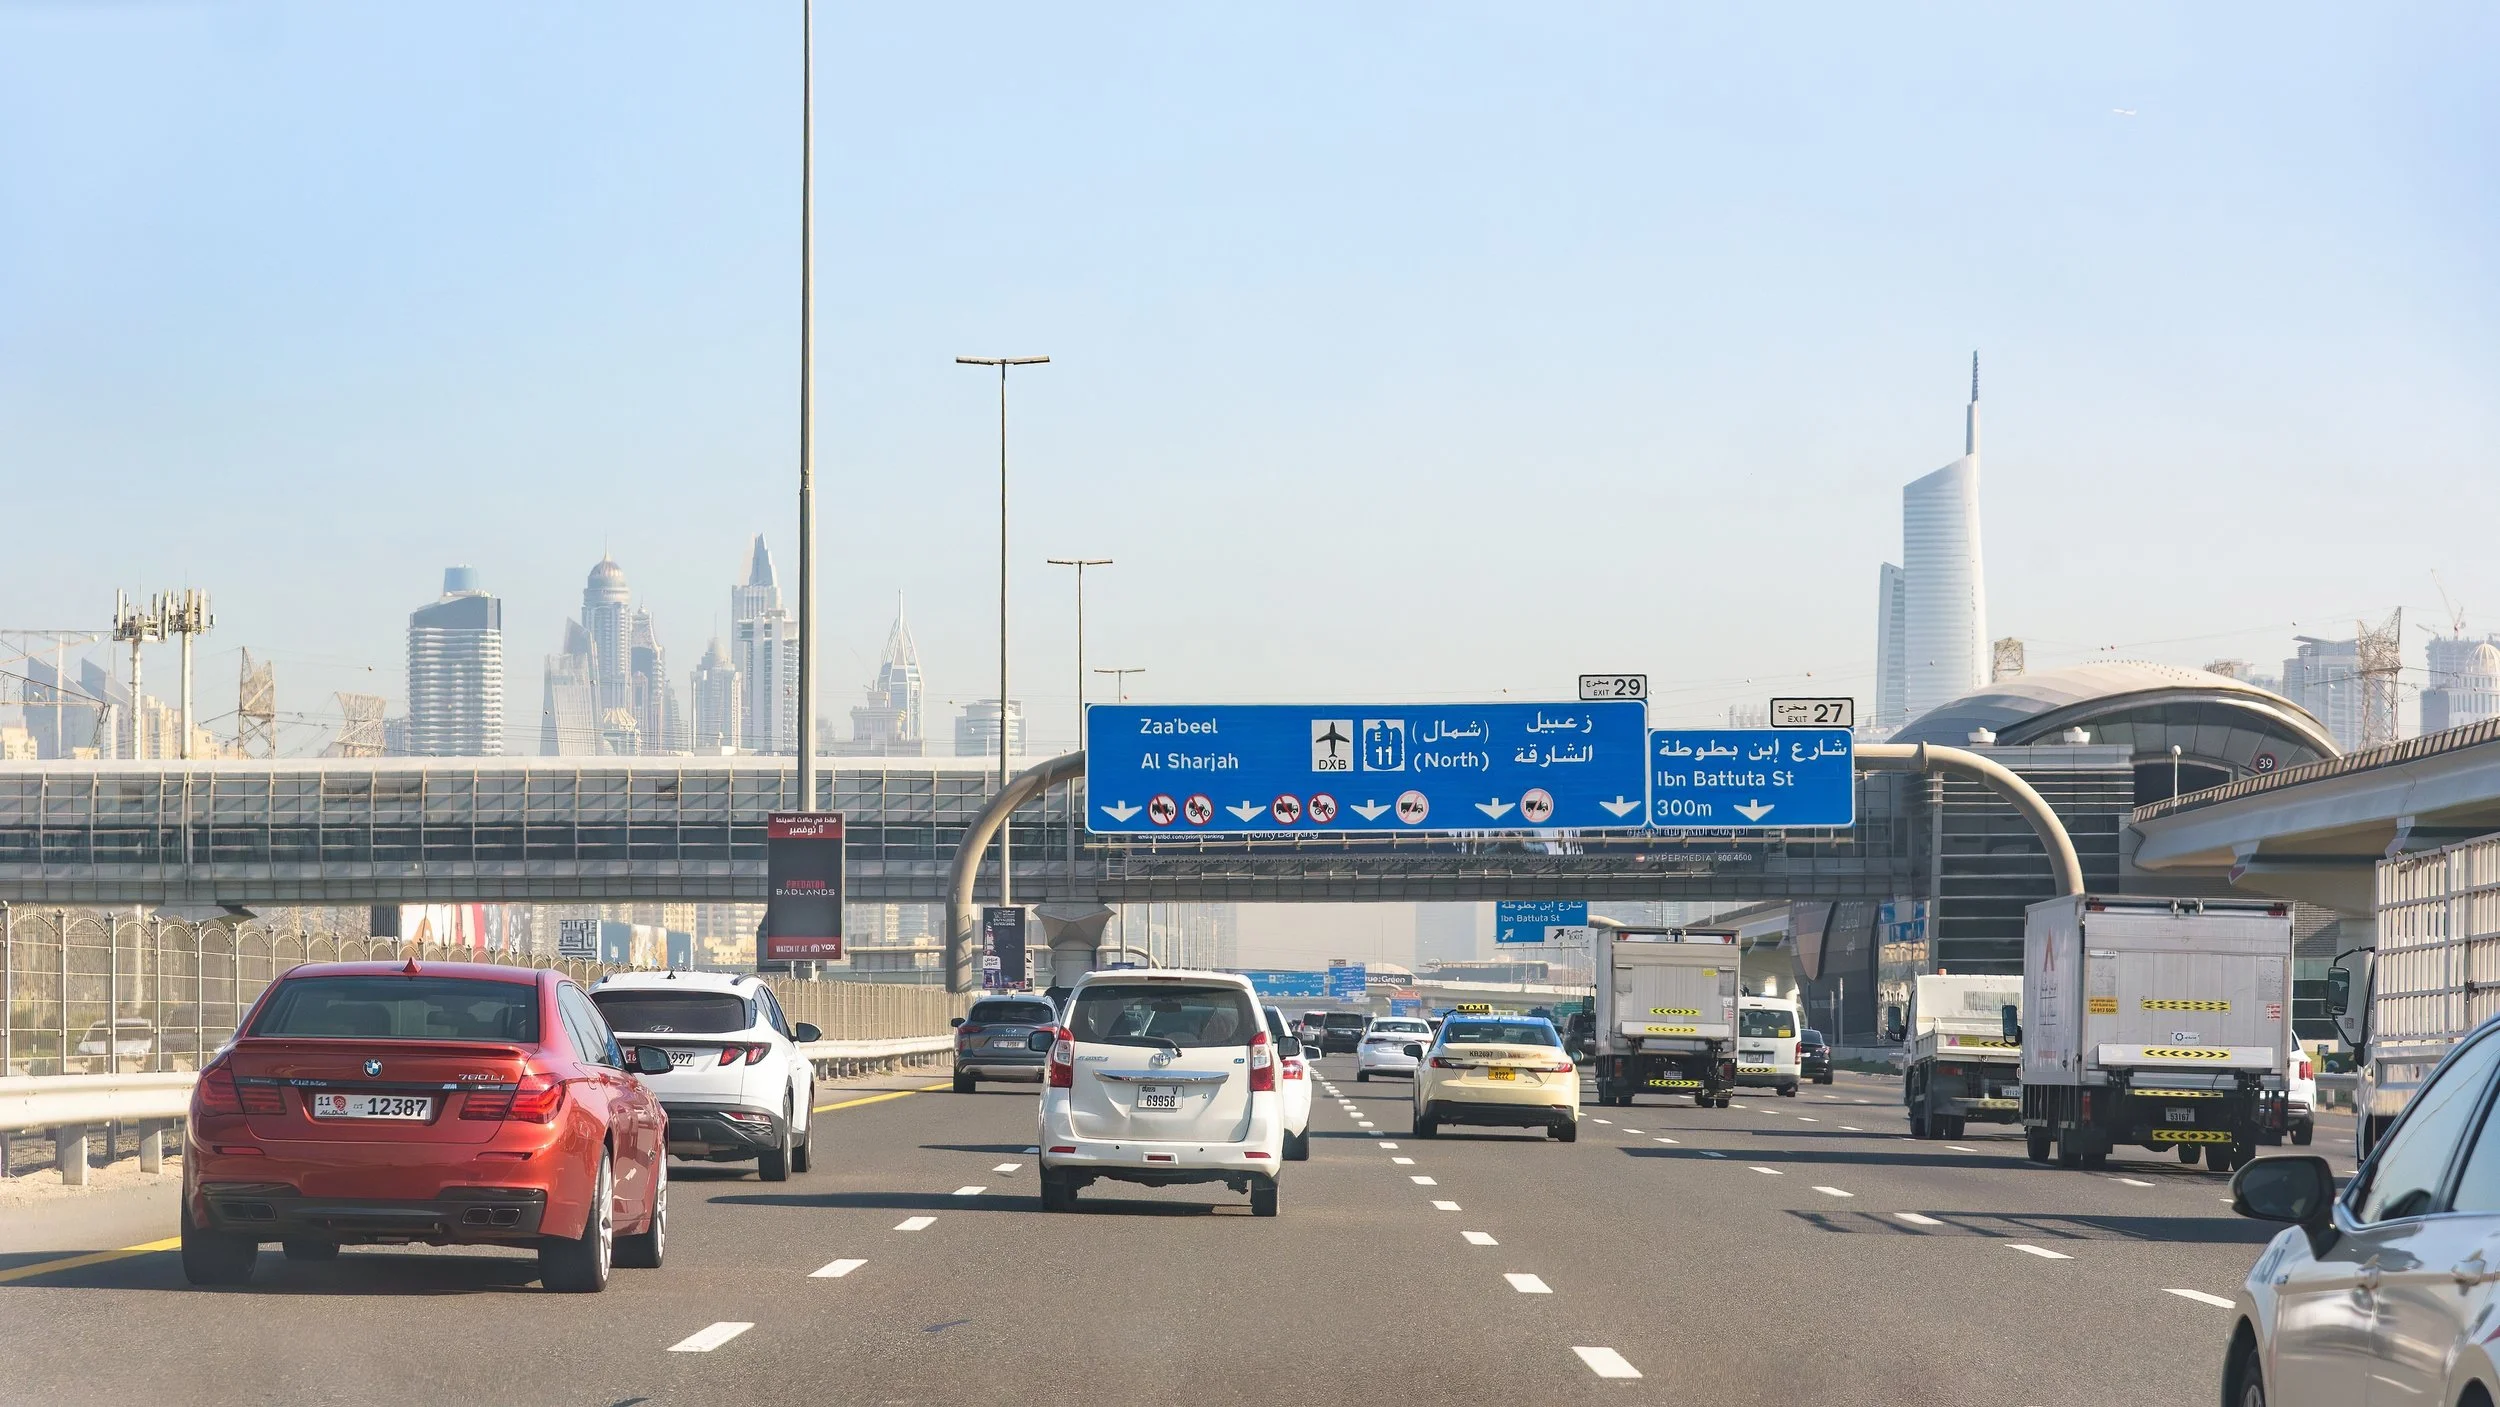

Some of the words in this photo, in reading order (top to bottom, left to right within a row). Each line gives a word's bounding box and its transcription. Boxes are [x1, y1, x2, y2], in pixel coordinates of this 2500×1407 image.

[1613, 679, 1641, 696] 29
[1778, 704, 1808, 713] مخرج
[1814, 704, 1844, 723] 27
[1526, 711, 1593, 734] زعبيل
[1787, 715, 1808, 723] EXIT
[1374, 731, 1382, 742] E
[1375, 746, 1393, 766] 11
[1514, 743, 1593, 768] الشارقة
[1659, 739, 1739, 762] بطوطة
[1791, 738, 1847, 763] شارع
[1141, 752, 1161, 769] Al
[1167, 752, 1239, 772] Sharjah
[1318, 759, 1347, 770] DXB
[1413, 752, 1490, 772] (North)
[2259, 758, 2273, 769] 39
[1657, 771, 1686, 787] Ibn
[1694, 771, 1766, 787] Battuta
[1772, 771, 1795, 787] St
[1657, 800, 1712, 817] 300m
[1646, 853, 1711, 862] HYPERMEDIA
[776, 888, 836, 896] BADLANDS
[1501, 914, 1515, 922] Ibn
[1516, 914, 1549, 922] Battuta
[1550, 914, 1560, 922] St
[820, 943, 836, 951] VOX
[669, 1052, 693, 1064] 997
[317, 1096, 331, 1106] 11
[367, 1097, 428, 1117] 12387
[1146, 1094, 1176, 1107] 69958
